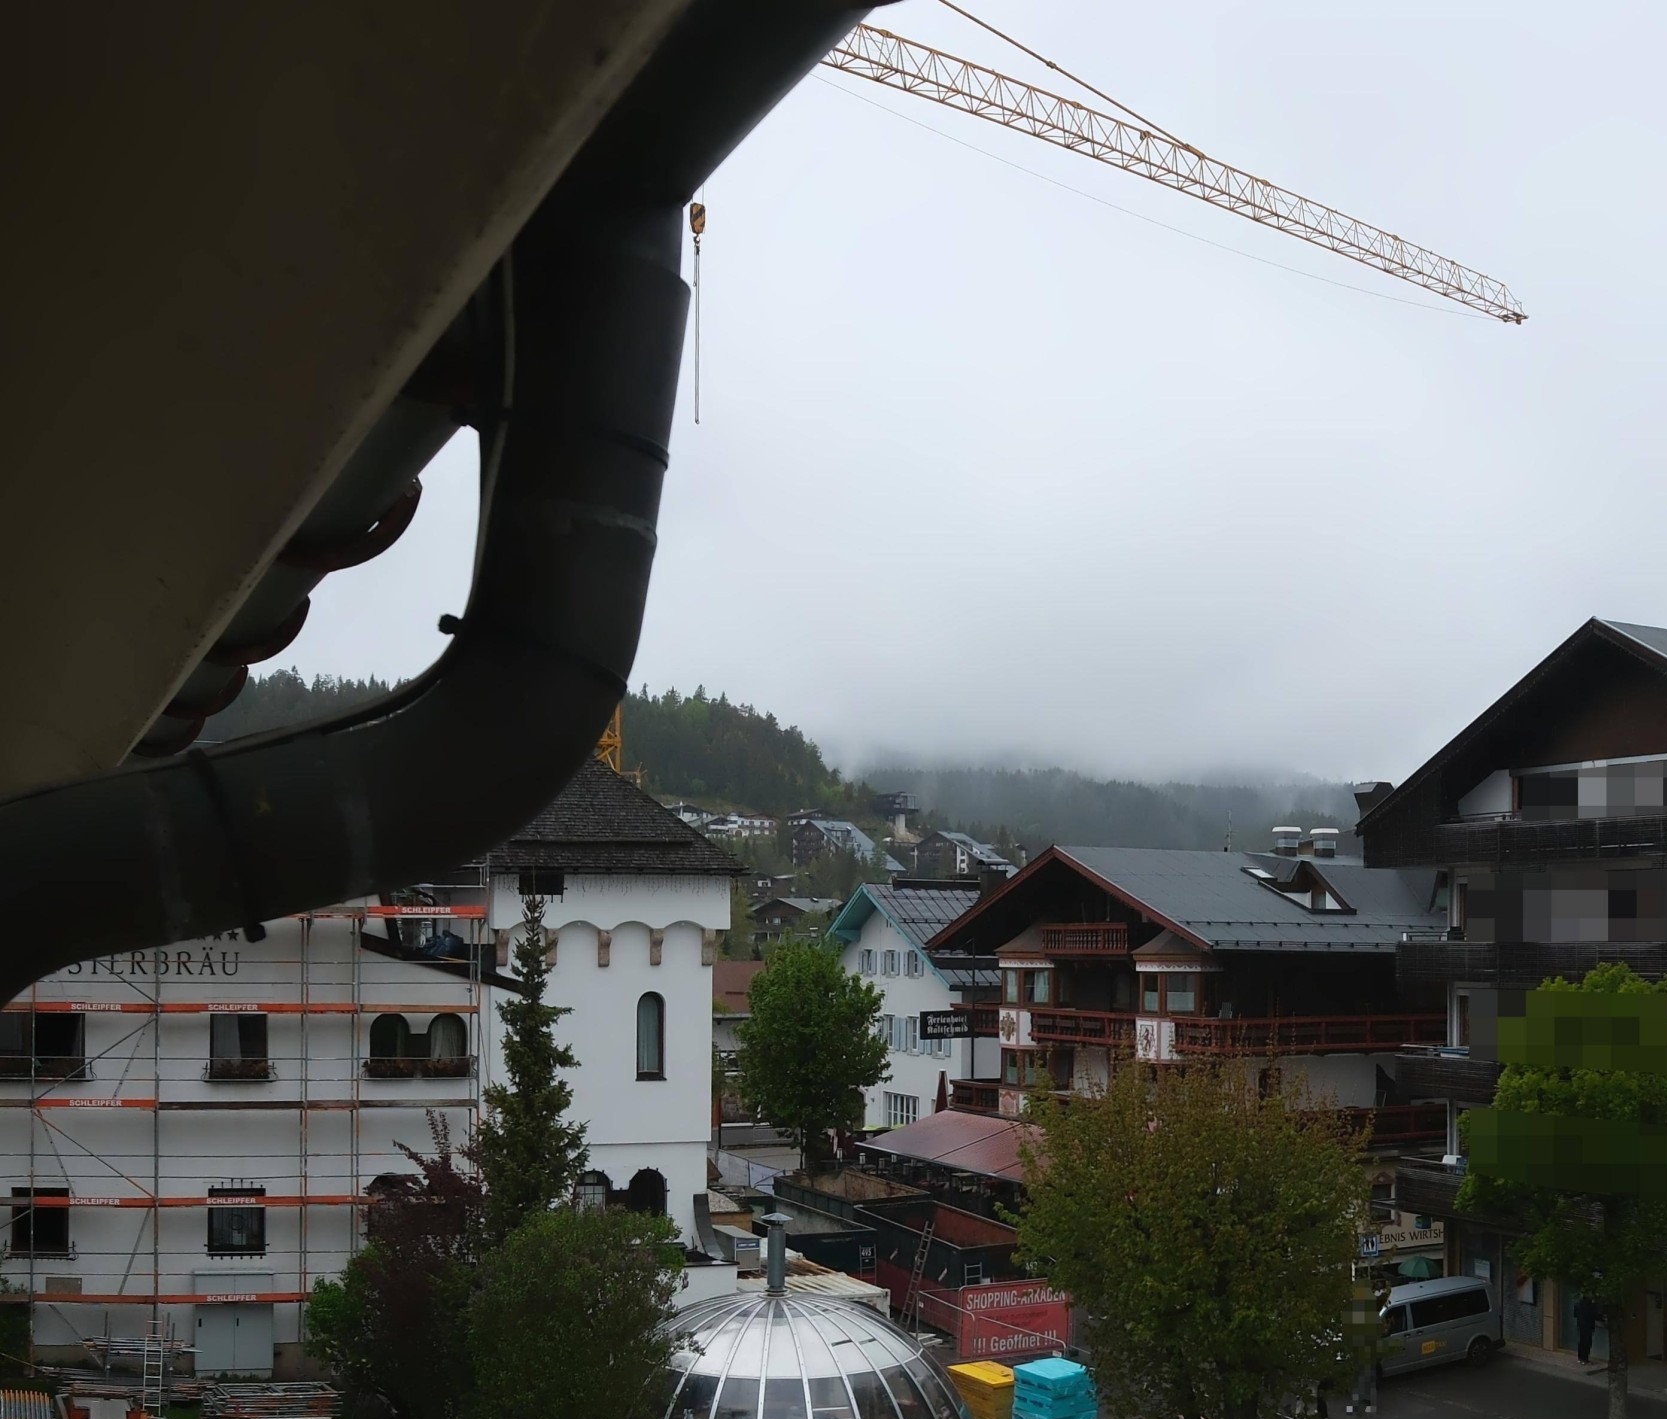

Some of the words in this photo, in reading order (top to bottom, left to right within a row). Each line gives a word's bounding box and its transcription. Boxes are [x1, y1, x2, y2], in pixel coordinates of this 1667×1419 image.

[401, 906, 452, 914] SCHLEIPFER
[66, 946, 240, 977] STERBRÄU
[71, 1003, 122, 1011] SCHLEIPFER
[207, 1003, 259, 1011] SCHLEIPFER
[69, 1099, 123, 1107] SCHLEIPFER
[69, 1197, 120, 1205] SCHLEIPFER
[206, 1196, 257, 1204] SCHLEIPFER
[990, 1333, 1041, 1352] Geöffnet
